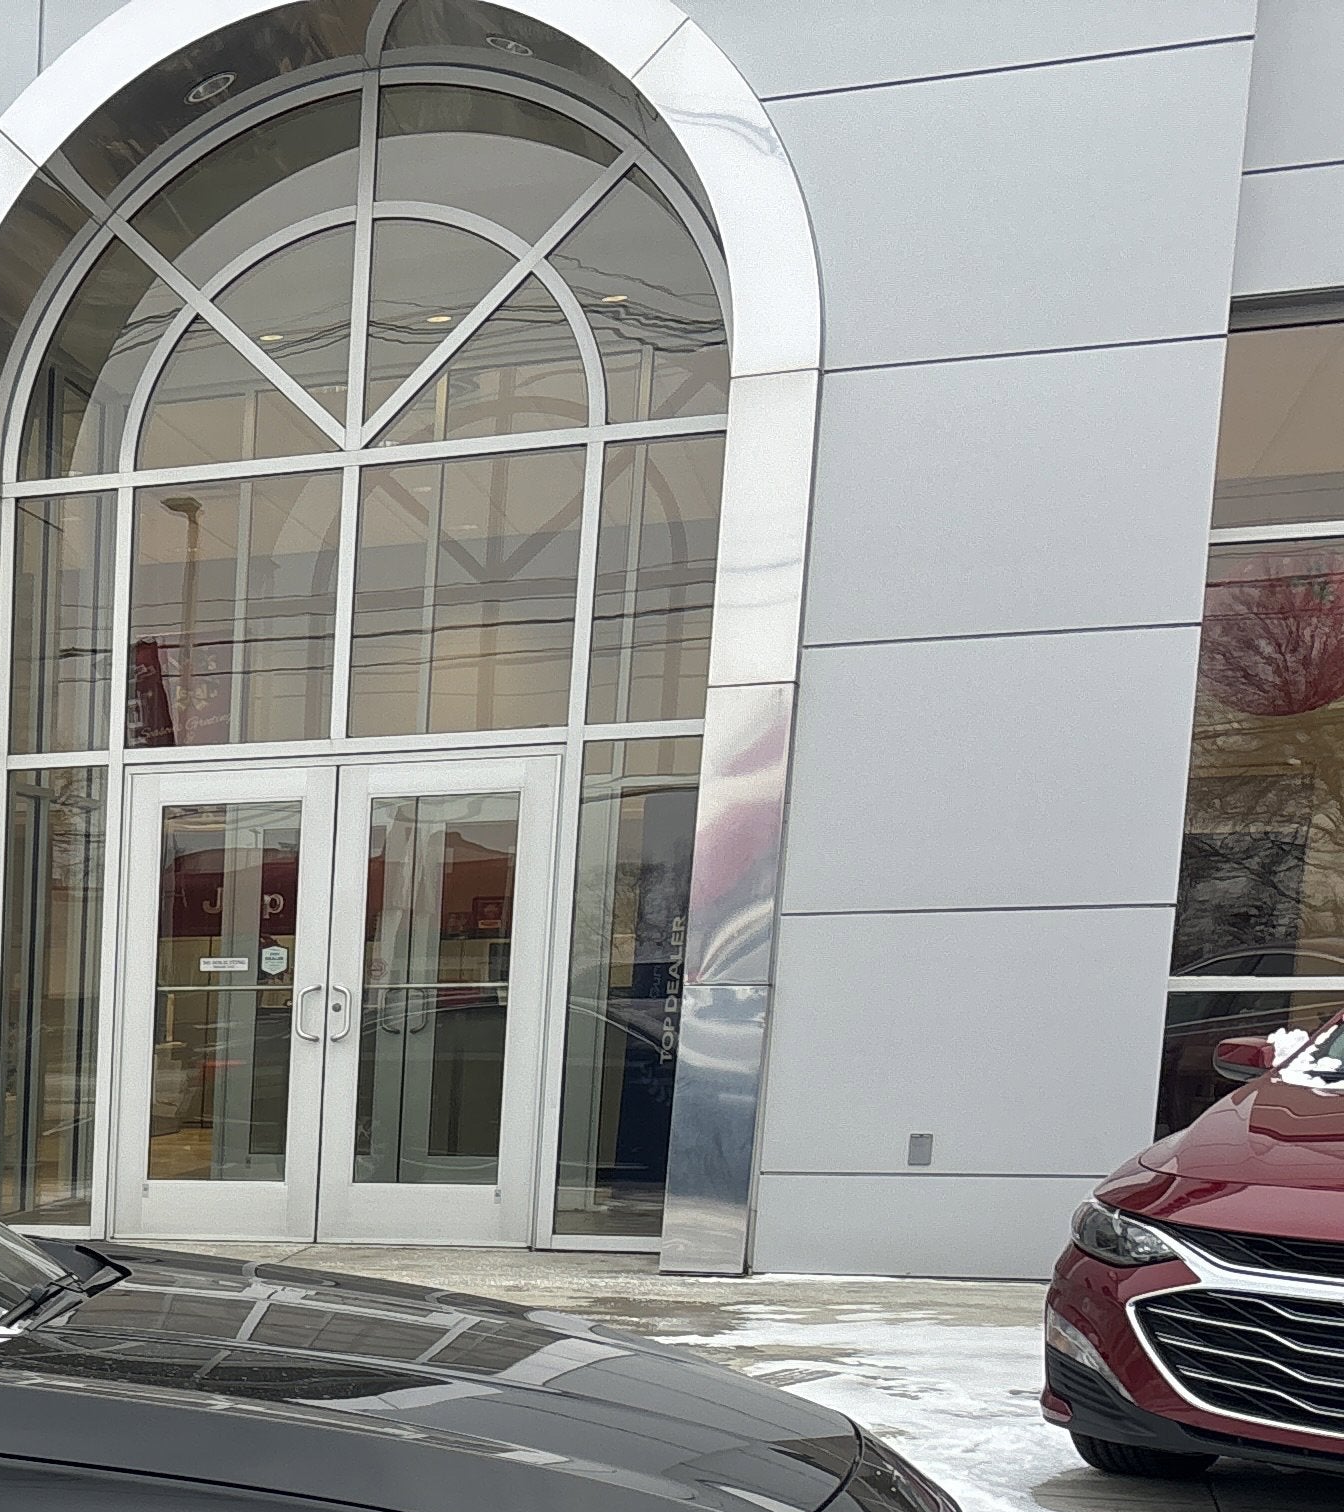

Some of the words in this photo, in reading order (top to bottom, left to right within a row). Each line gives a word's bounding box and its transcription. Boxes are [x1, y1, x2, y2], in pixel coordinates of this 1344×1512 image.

[202, 887, 284, 919] Jp
[664, 915, 686, 1014] DEALER
[659, 1016, 676, 1065] TOP
